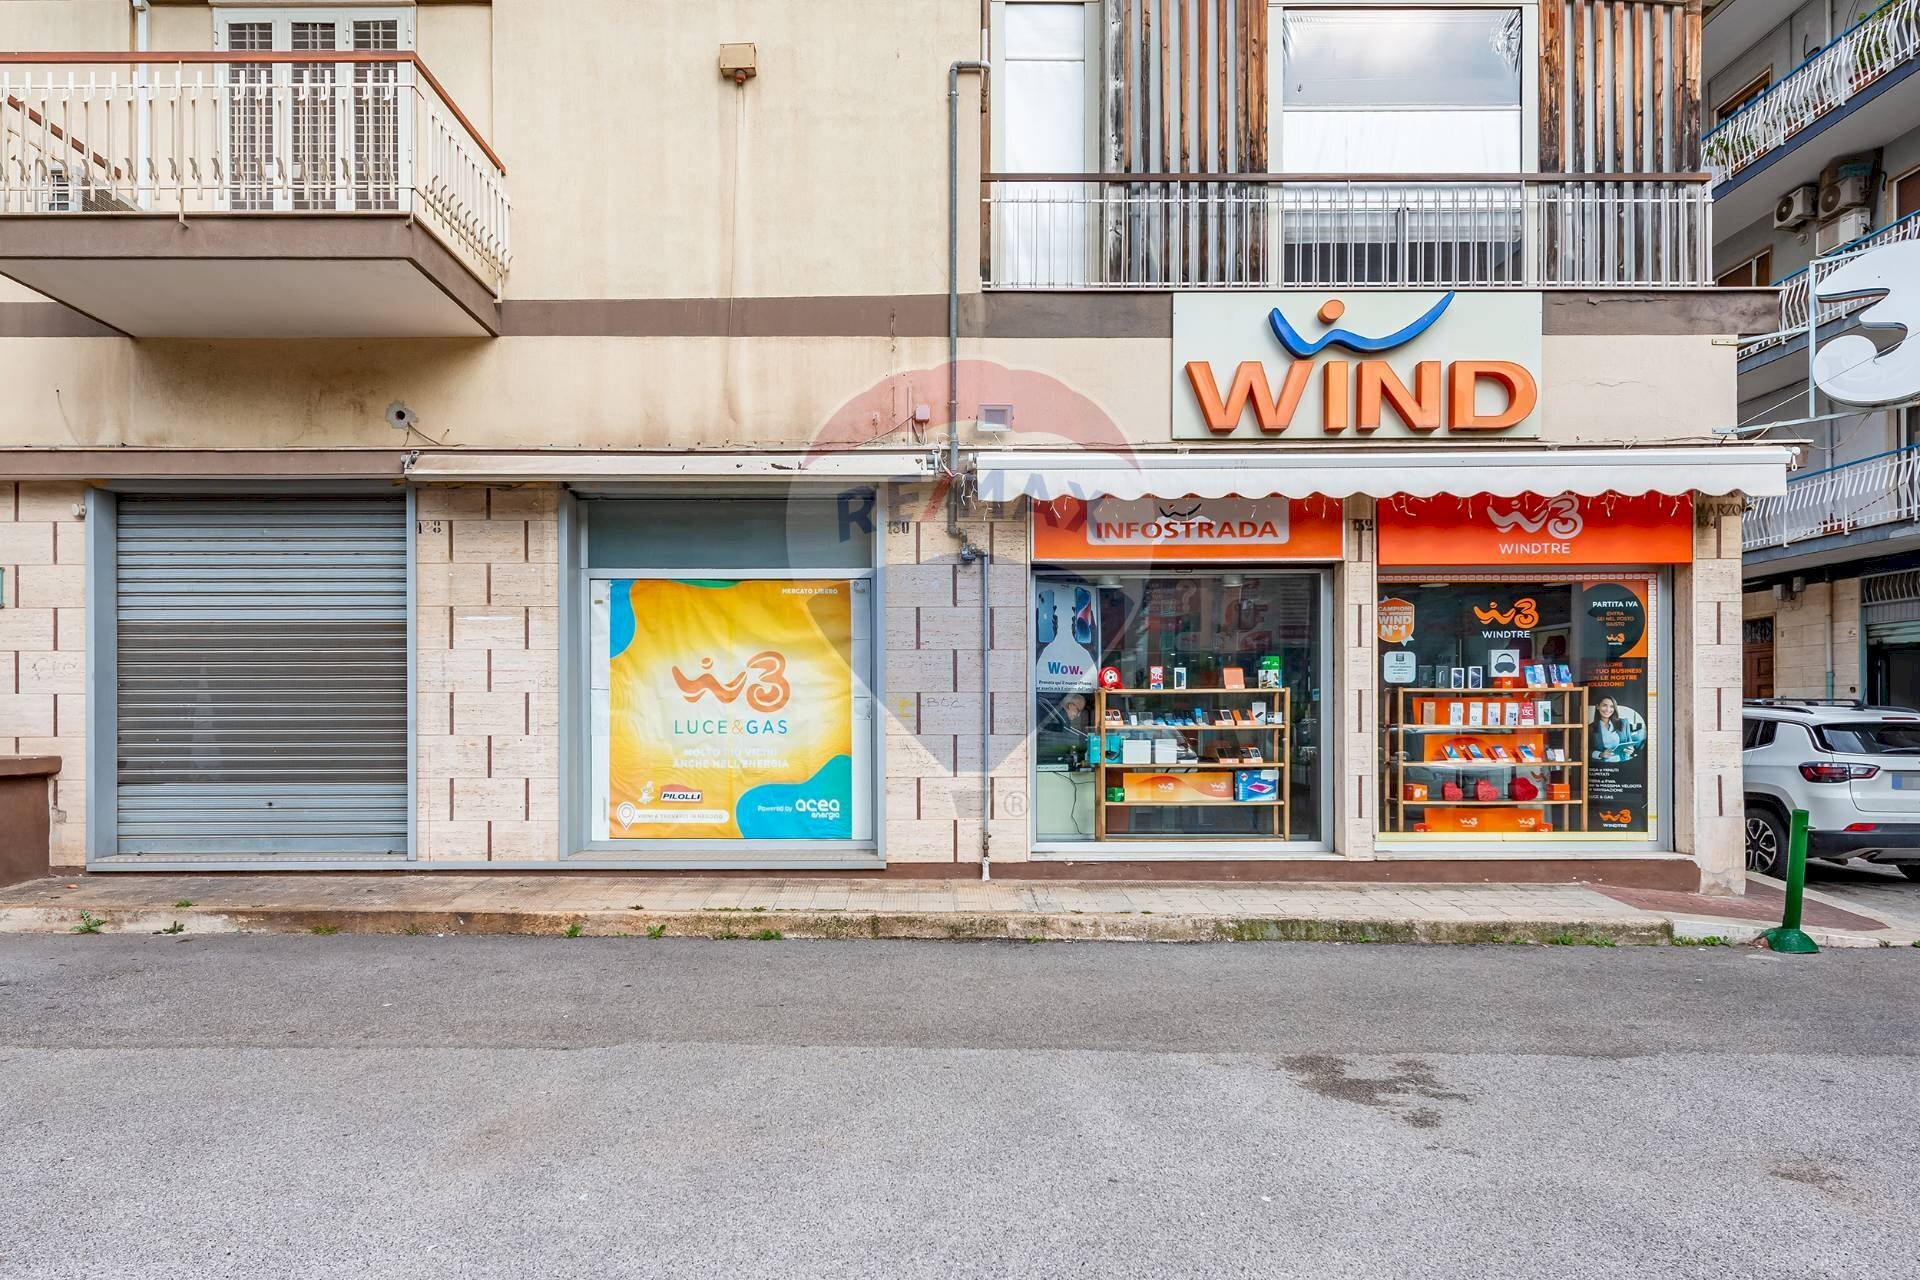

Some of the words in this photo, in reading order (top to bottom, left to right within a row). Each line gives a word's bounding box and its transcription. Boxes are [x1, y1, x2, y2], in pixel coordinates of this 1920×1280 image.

[1185, 360, 1538, 434] WIND
[1096, 520, 1279, 539] INFOSTRADA
[1499, 543, 1571, 554] WINDTRE
[1379, 615, 1412, 625] WIND
[1482, 631, 1530, 639] WINDTRE
[1047, 661, 1083, 675] Wow.
[795, 799, 840, 812] acea
